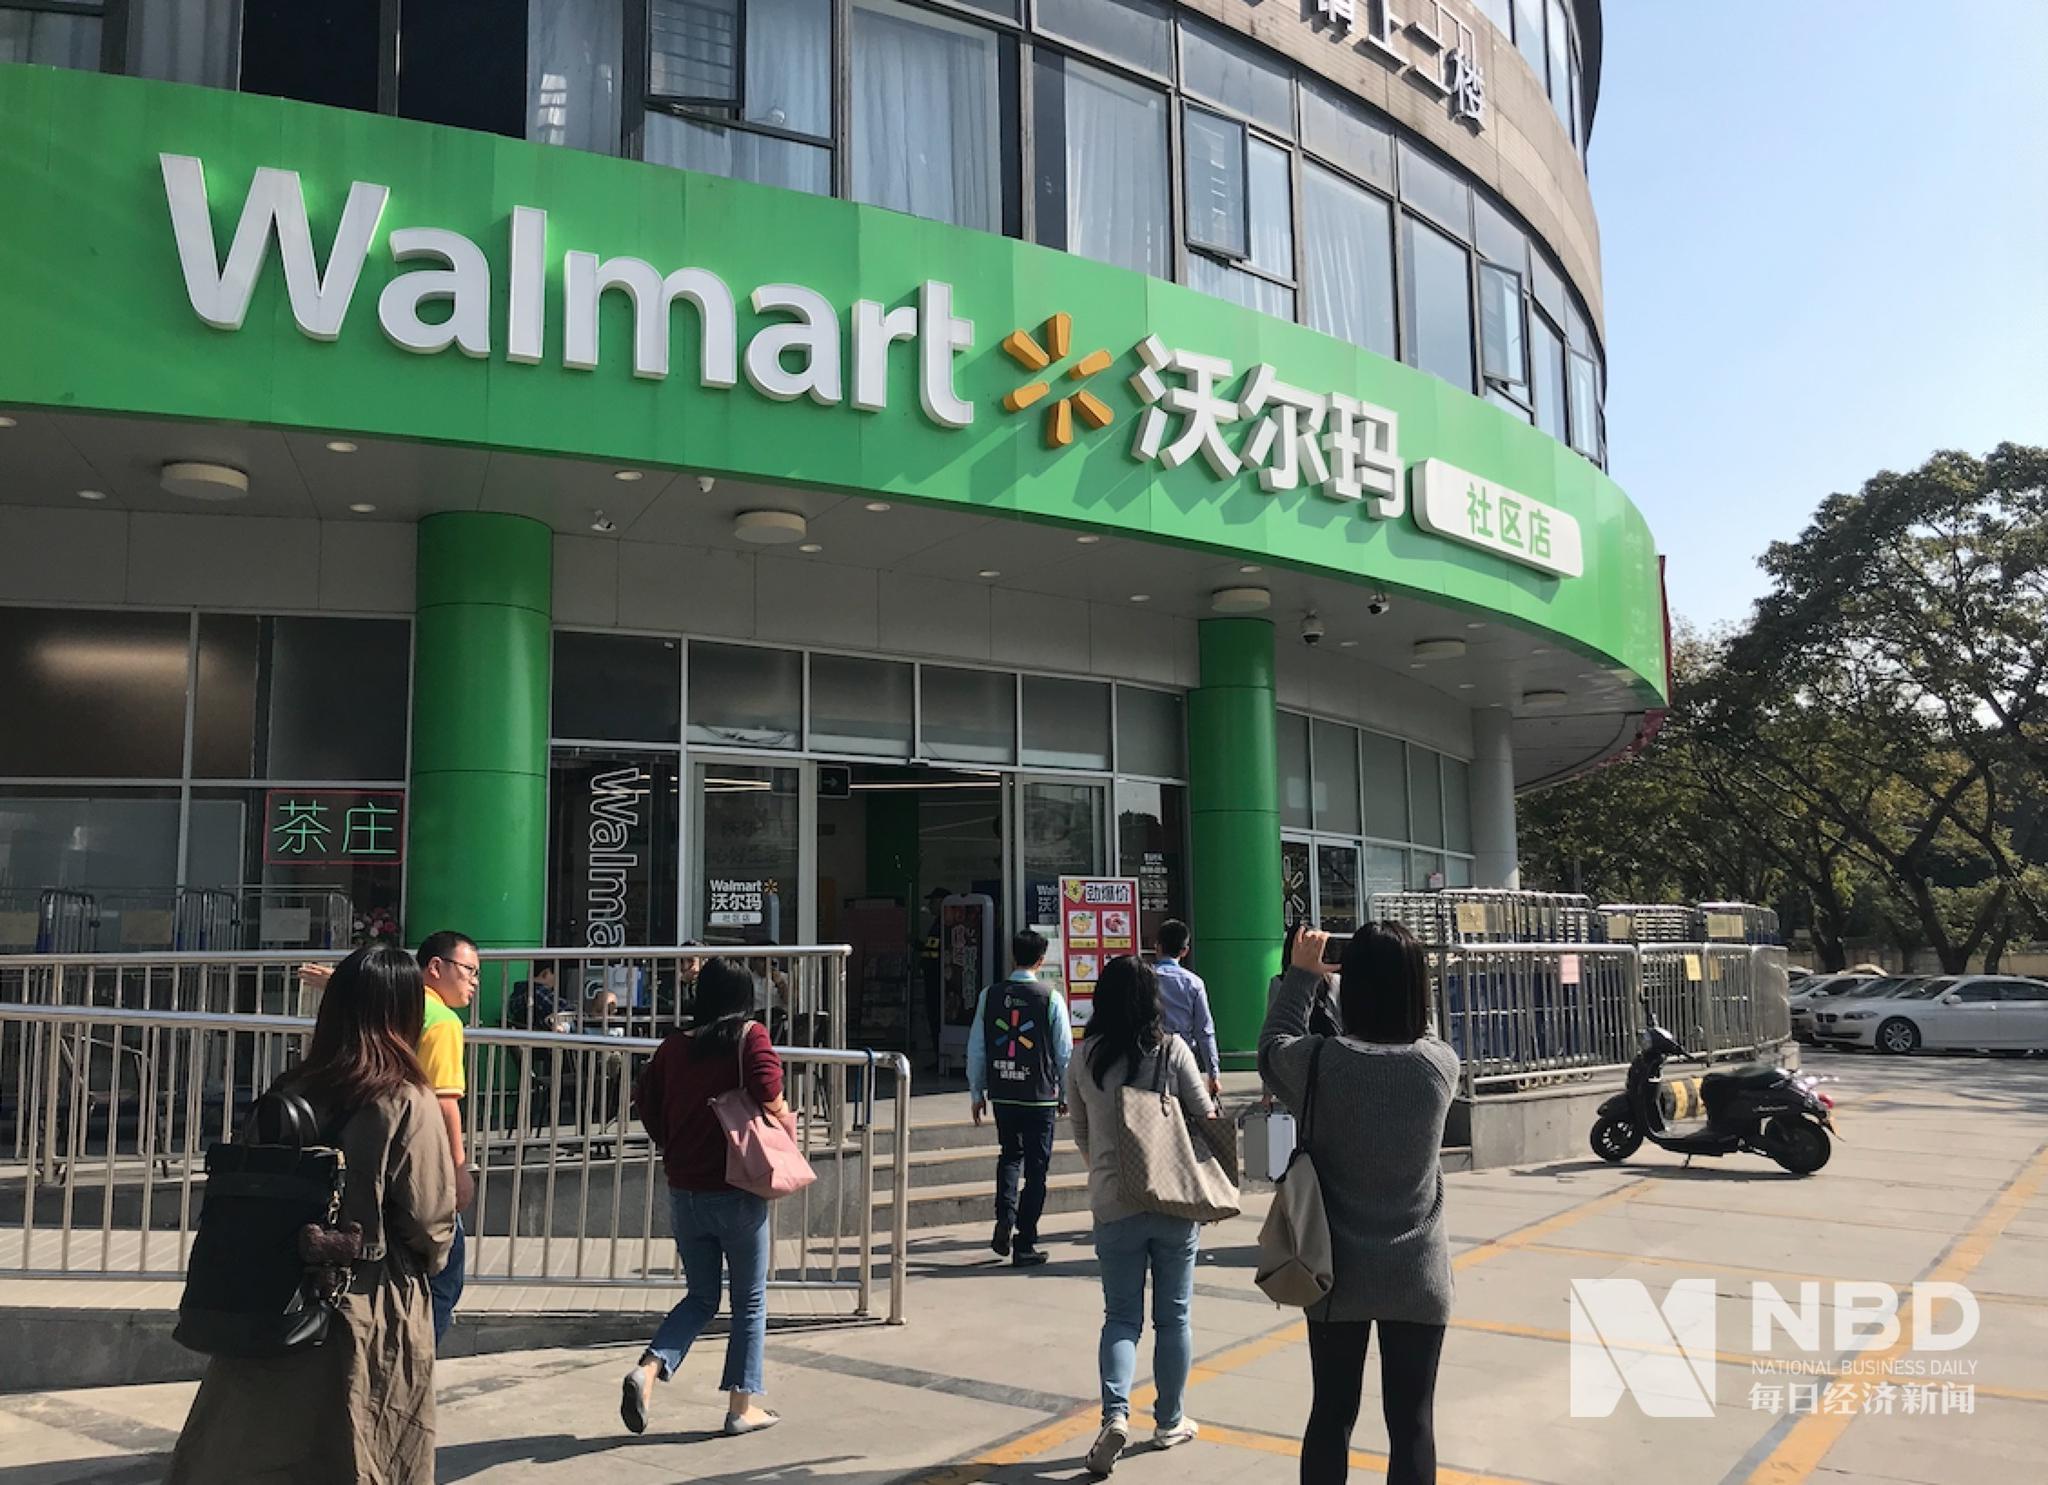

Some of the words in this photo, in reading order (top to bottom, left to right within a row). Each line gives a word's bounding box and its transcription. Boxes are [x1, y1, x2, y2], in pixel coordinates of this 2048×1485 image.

[160, 153, 975, 428] Walmart
[1129, 333, 1406, 520] 沃尔玛
[1466, 481, 1552, 559] 社区店
[272, 799, 398, 854] 茶庄
[710, 879, 762, 892] Walmart
[711, 893, 761, 910] 沃尔玛
